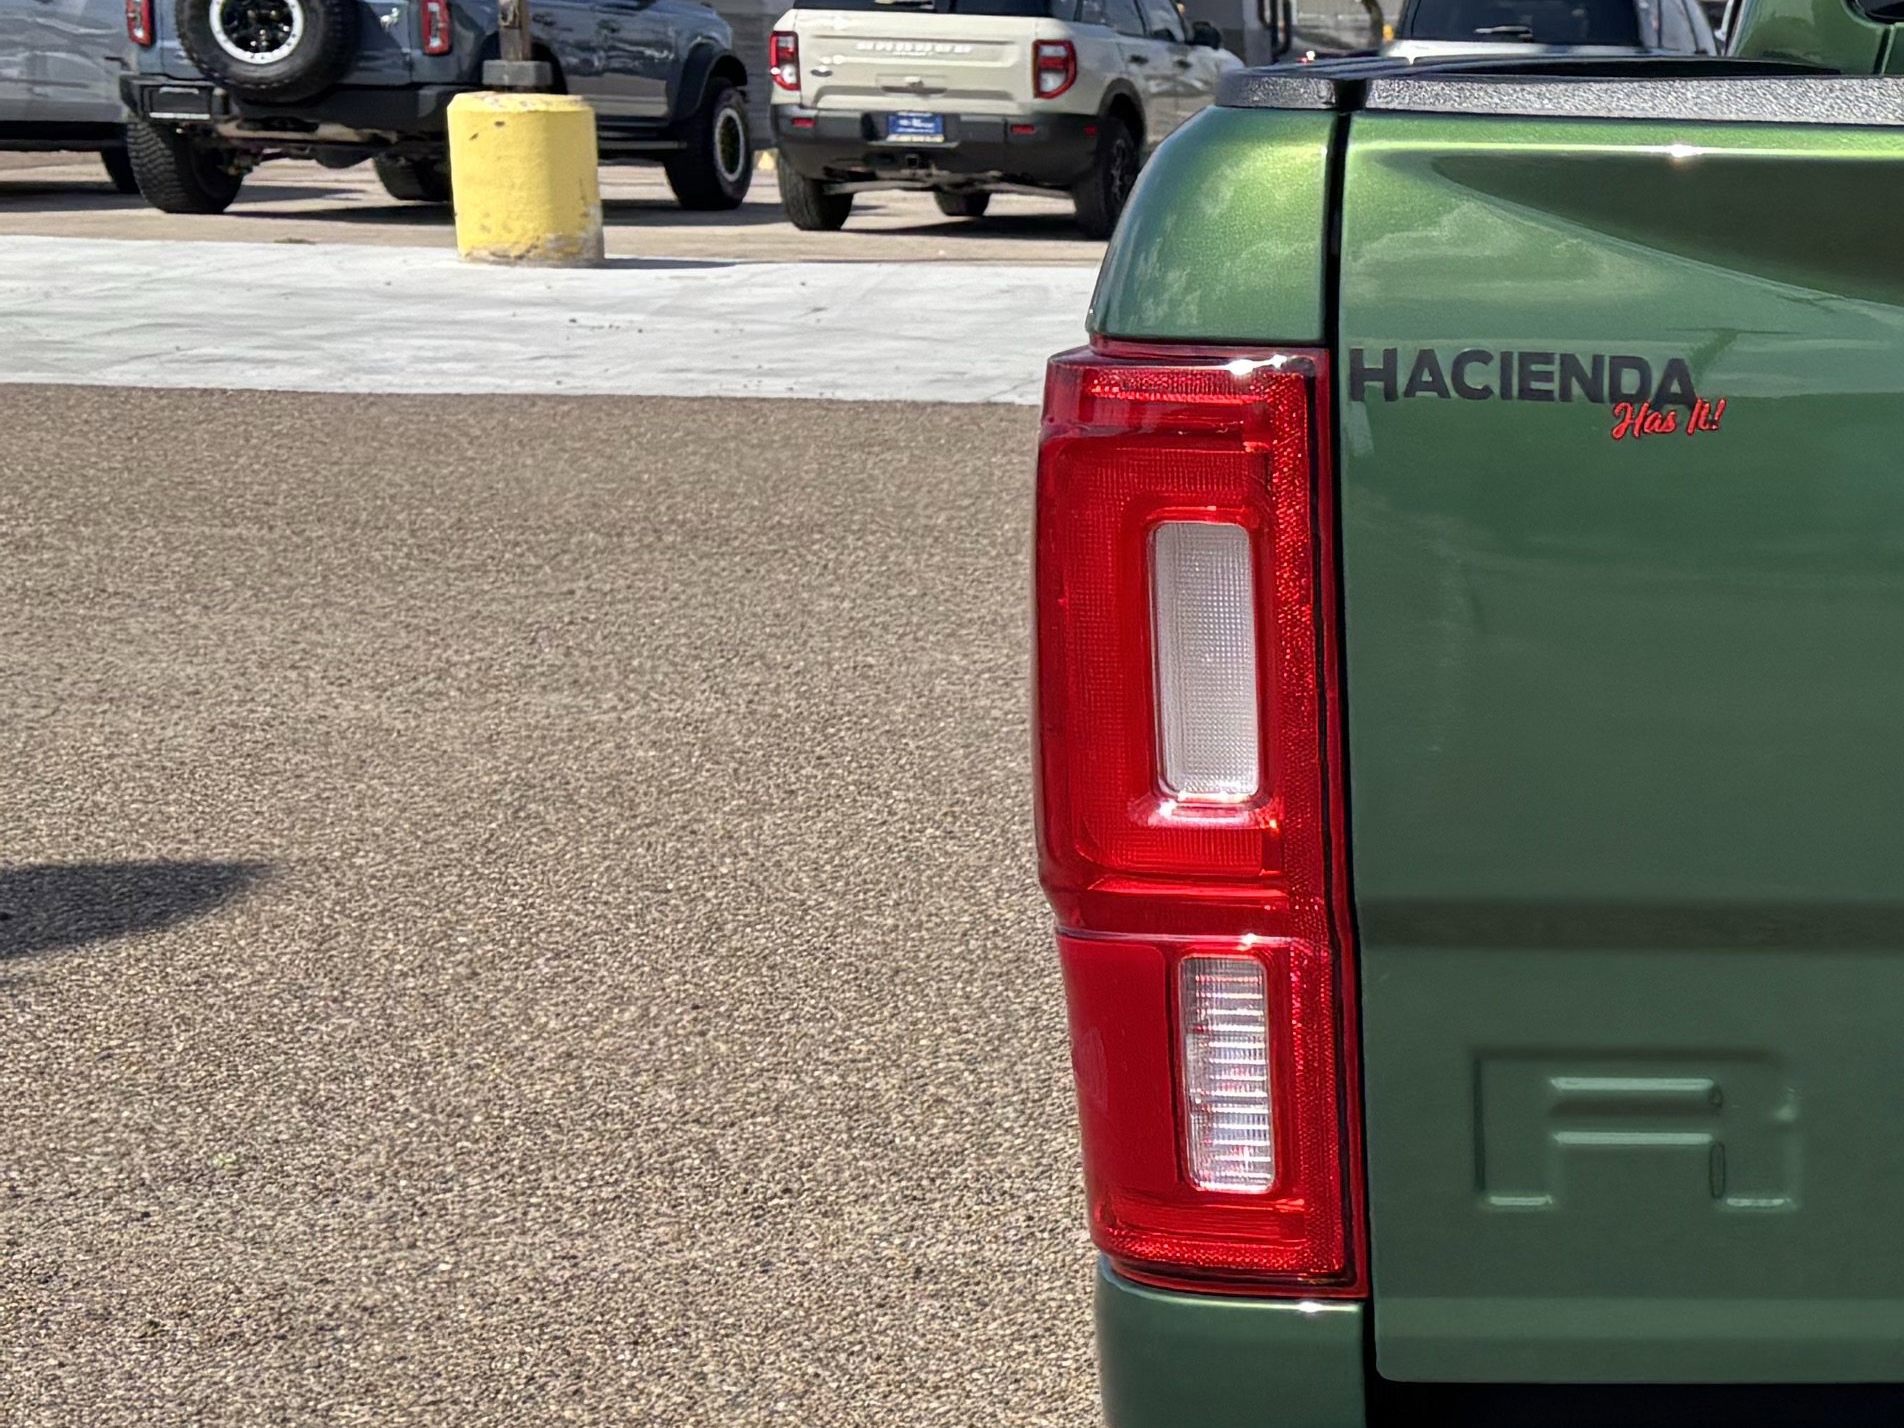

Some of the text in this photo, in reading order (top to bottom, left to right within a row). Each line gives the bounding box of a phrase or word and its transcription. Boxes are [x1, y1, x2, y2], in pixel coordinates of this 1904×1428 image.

[1348, 347, 1698, 412] HACIENDA
[1610, 397, 1728, 440] Has It!
